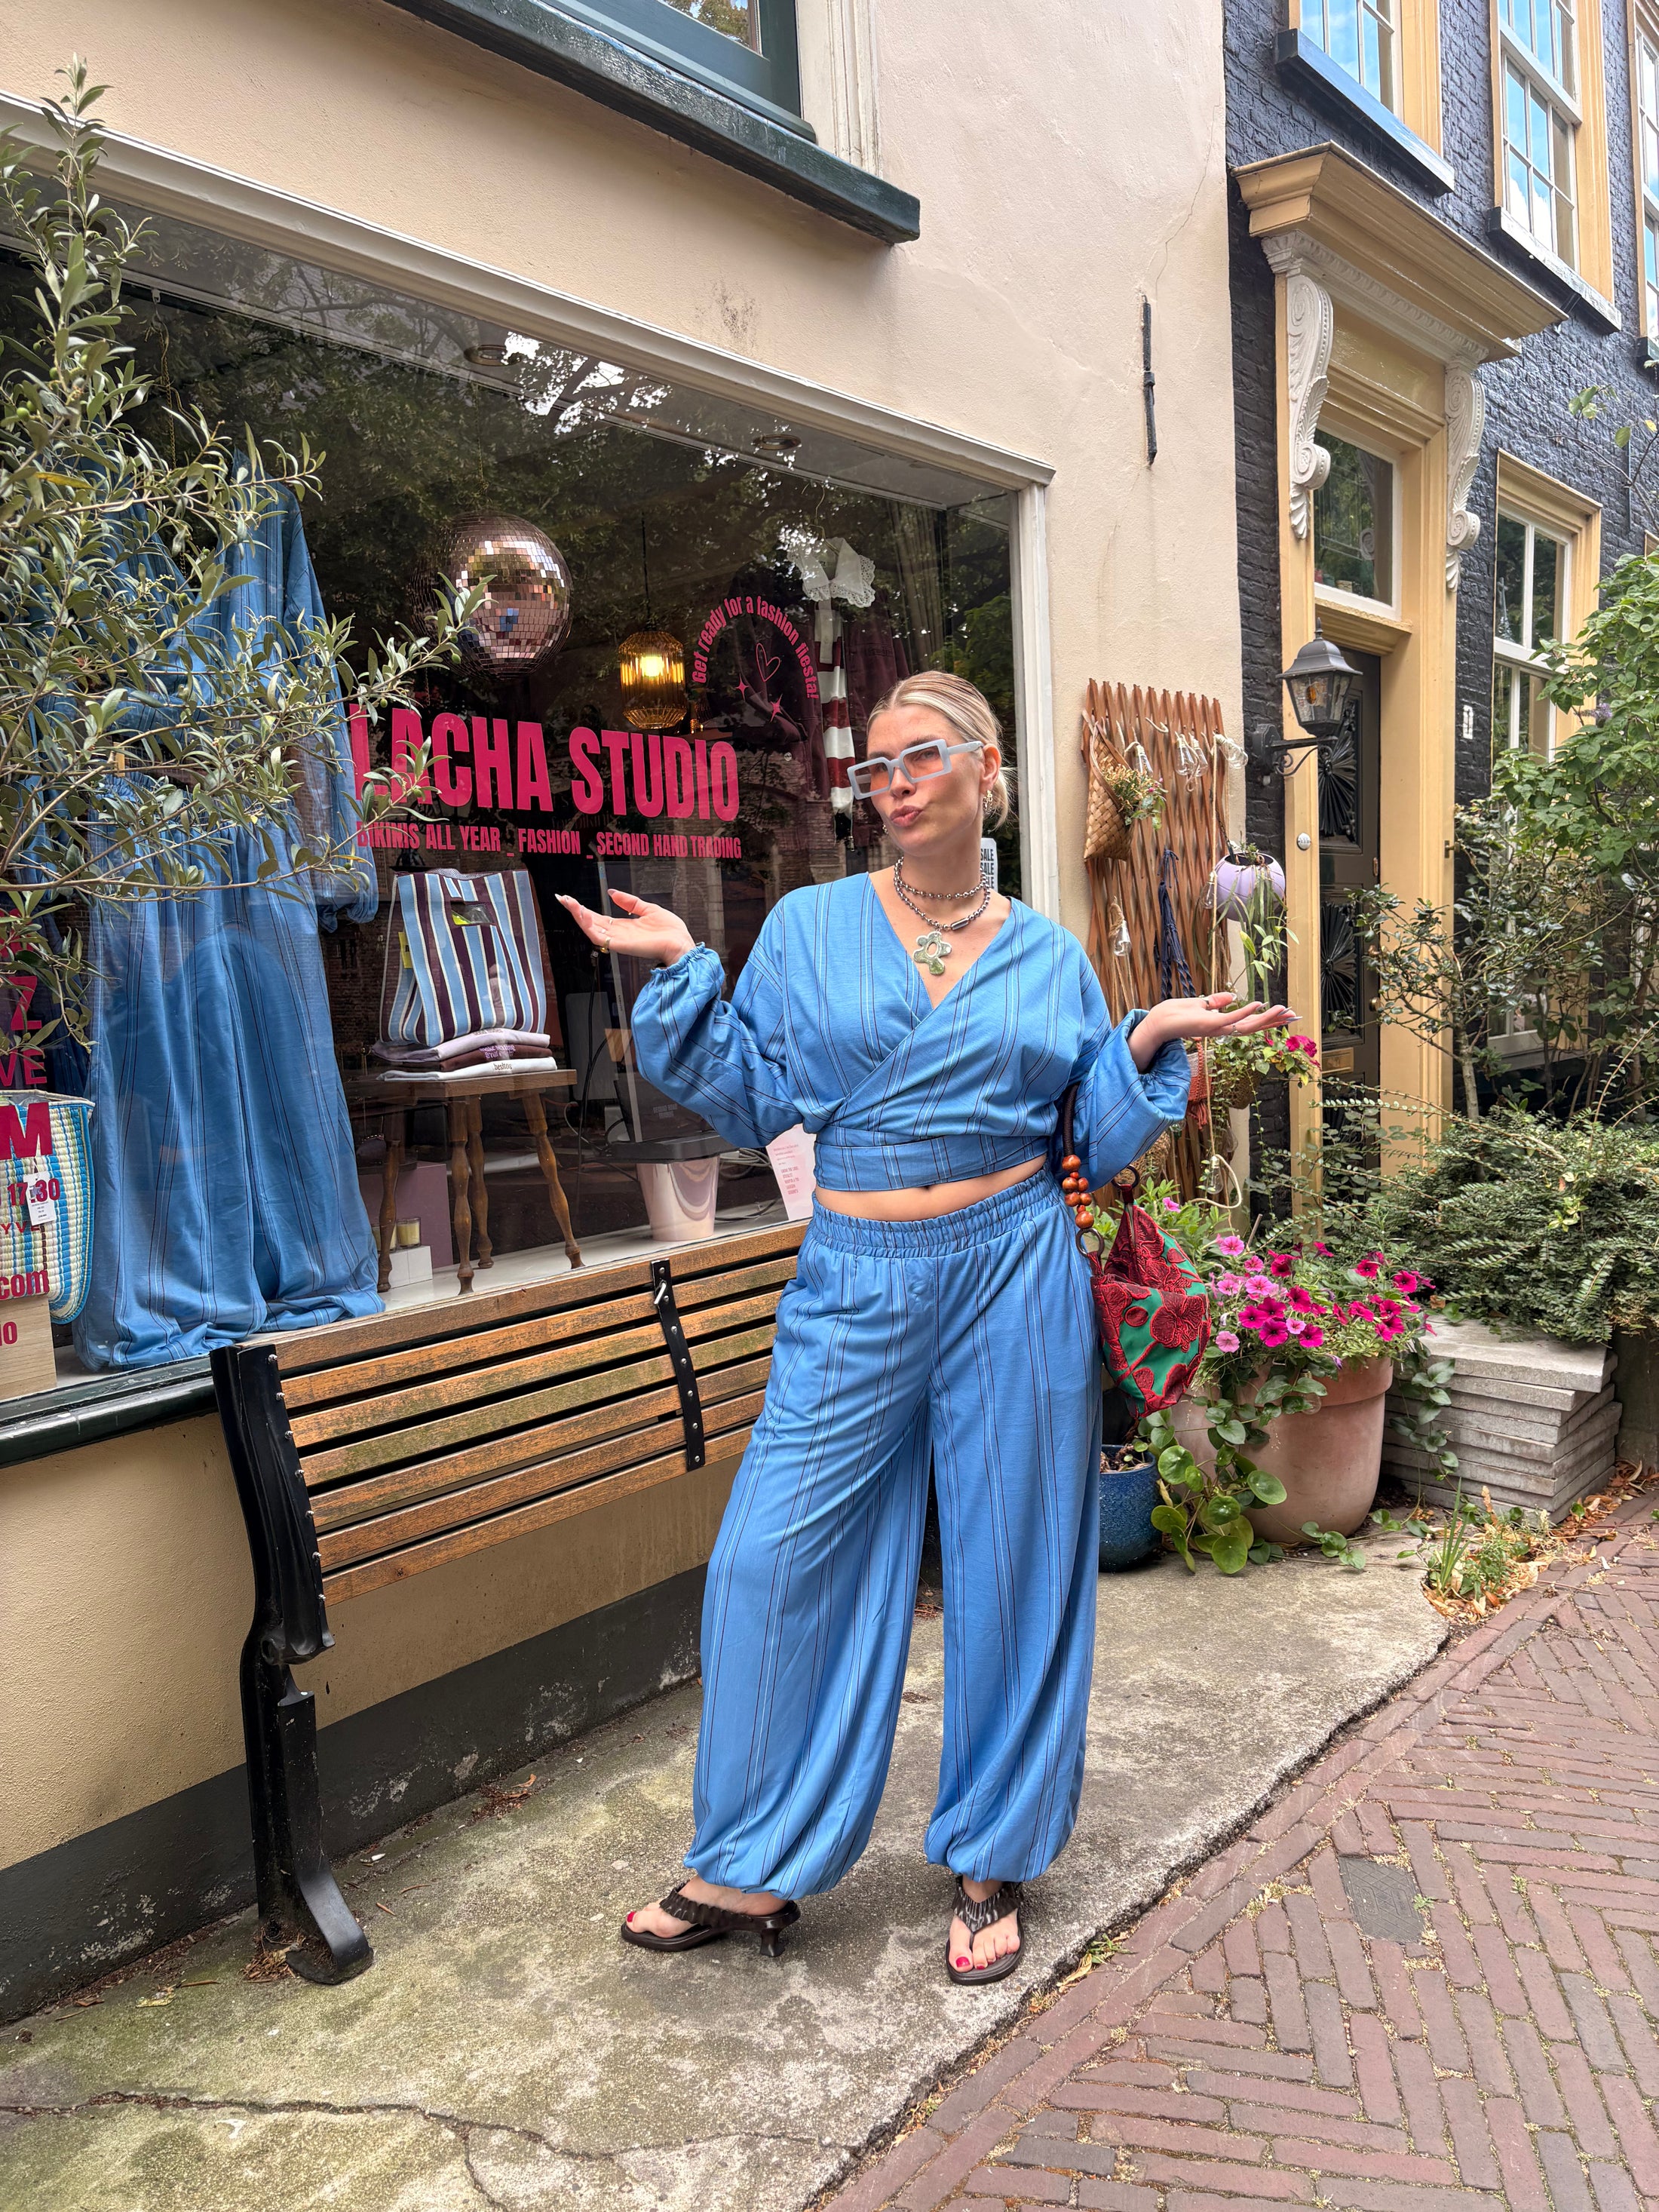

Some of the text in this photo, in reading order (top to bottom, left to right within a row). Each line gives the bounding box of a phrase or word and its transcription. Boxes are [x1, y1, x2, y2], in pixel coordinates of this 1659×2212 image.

[692, 595, 820, 700] Get ready for a fashion fiesta!
[348, 703, 740, 822] LACHA STUDIO
[356, 821, 420, 849] BIKINIS
[426, 824, 455, 850] ALL
[459, 825, 501, 851] YEAR
[518, 828, 581, 854] FASHION
[596, 831, 649, 856] SECOND
[653, 834, 688, 857] HAND
[690, 836, 742, 859] TRADING
[980, 848, 994, 861] SALE
